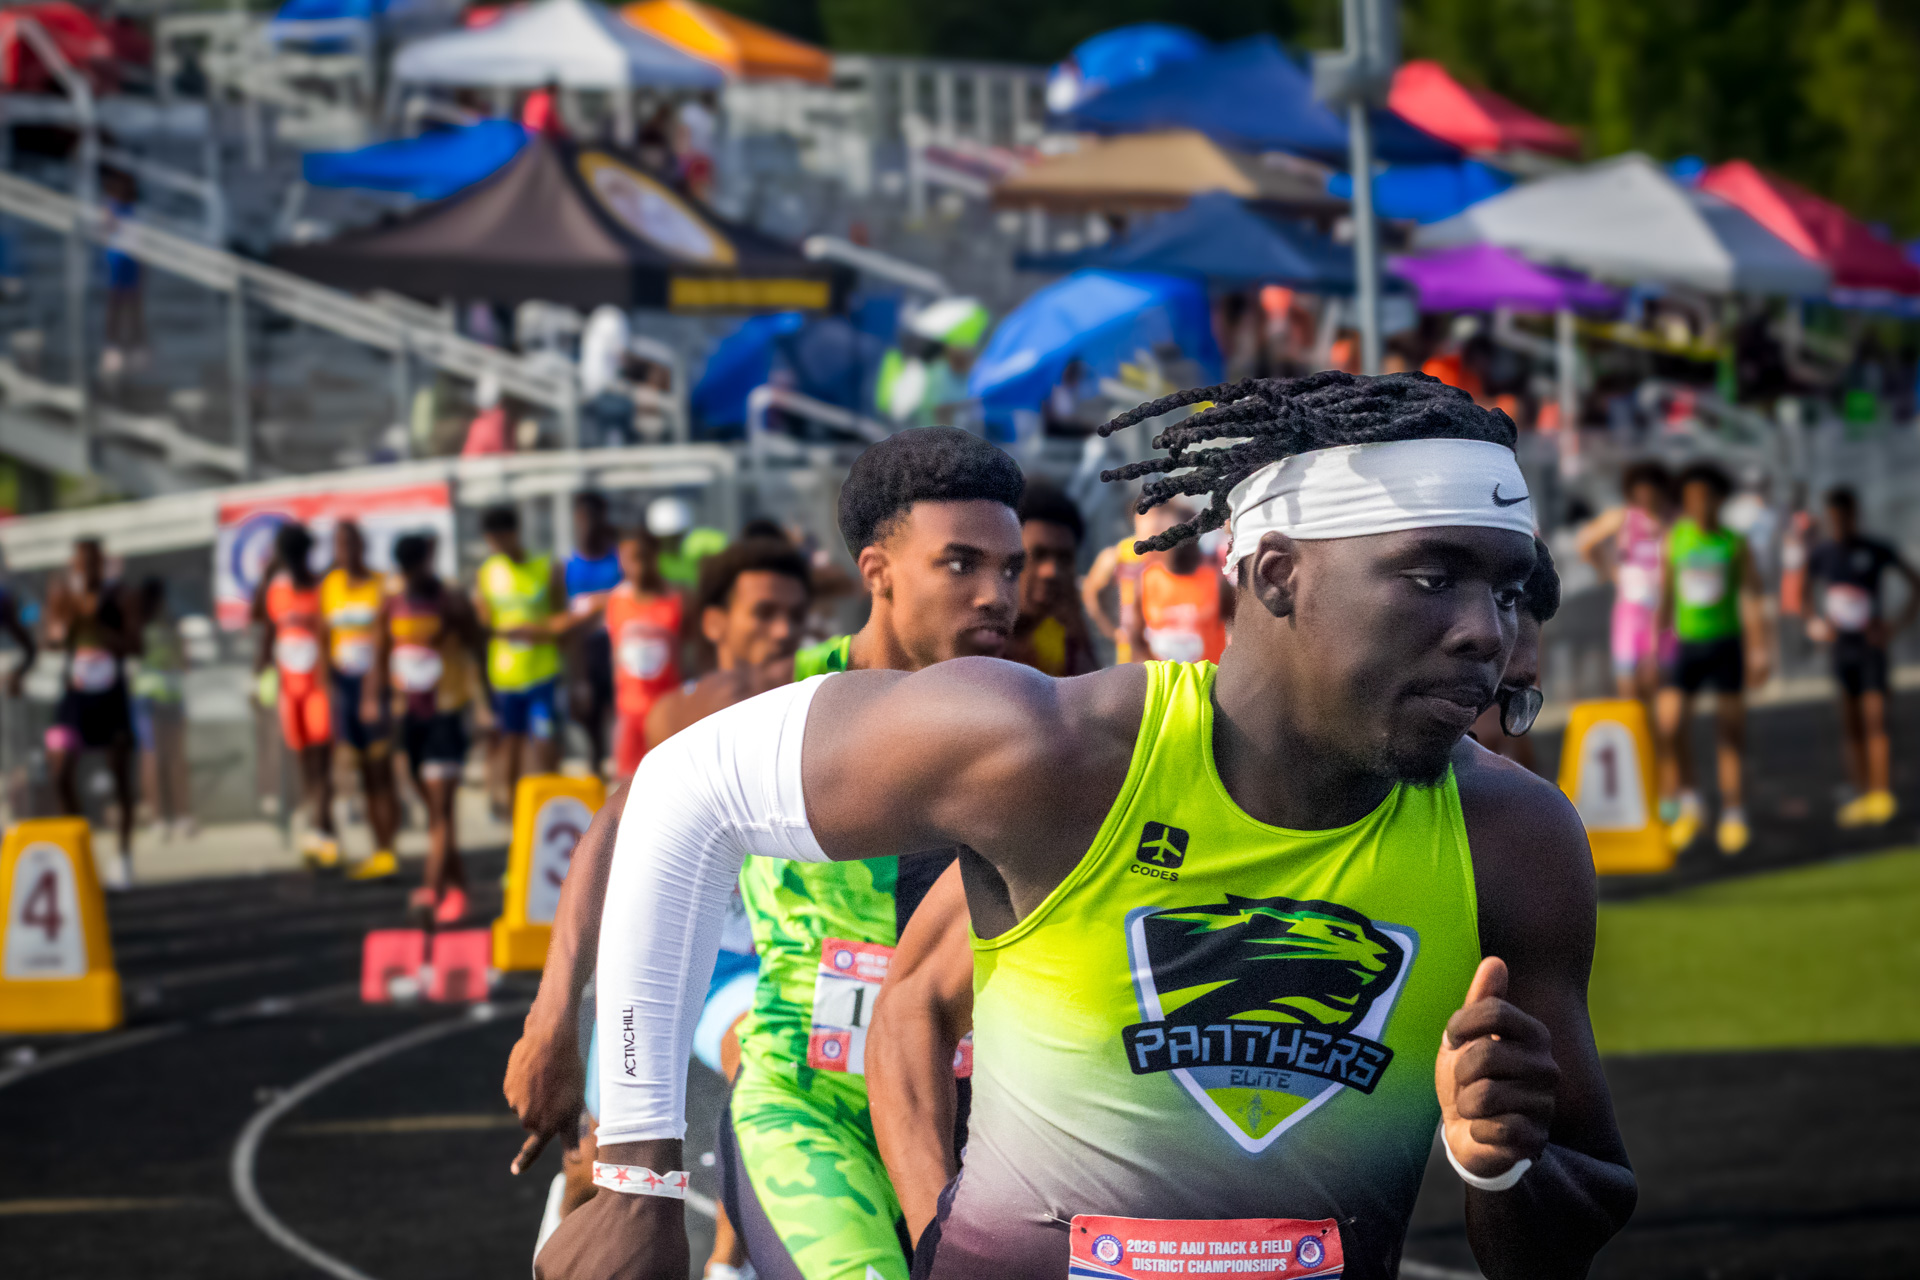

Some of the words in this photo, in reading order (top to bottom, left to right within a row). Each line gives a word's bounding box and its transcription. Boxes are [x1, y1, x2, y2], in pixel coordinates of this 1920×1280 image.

[1597, 746, 1618, 799] 1
[1130, 864, 1179, 881] CODES
[21, 869, 62, 941] 4
[622, 1005, 637, 1078] ACTIVCHILL
[1134, 1024, 1386, 1087] PANTHERS
[1126, 1239, 1157, 1253] 2026
[1159, 1240, 1177, 1254] NC
[1180, 1241, 1206, 1254] AAU
[1207, 1240, 1246, 1254] TRACK
[1249, 1240, 1259, 1254] &
[1261, 1239, 1292, 1253] FIELD
[1132, 1257, 1185, 1272] DISTRICT
[1188, 1258, 1287, 1273] CHAMPIONSHIPS
